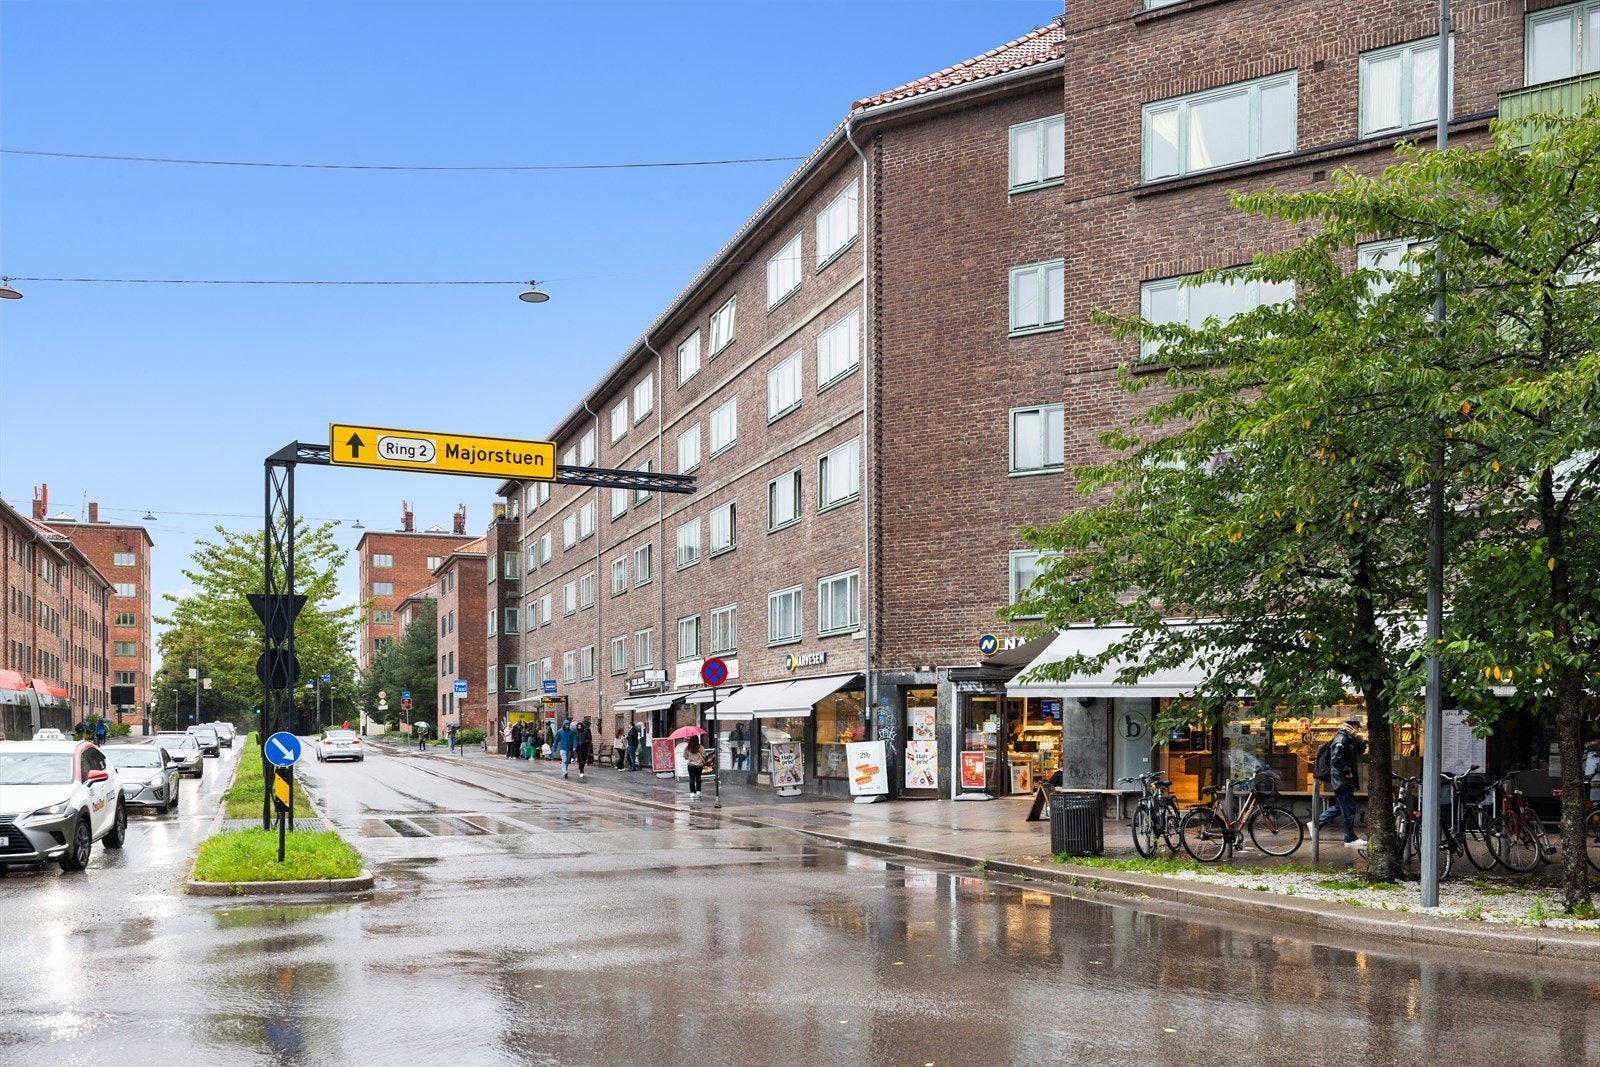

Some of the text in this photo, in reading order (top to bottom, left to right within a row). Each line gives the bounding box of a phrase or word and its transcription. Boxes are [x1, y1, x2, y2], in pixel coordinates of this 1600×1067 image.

[386, 442, 427, 458] Ring 2
[445, 443, 544, 466] Majorstuen
